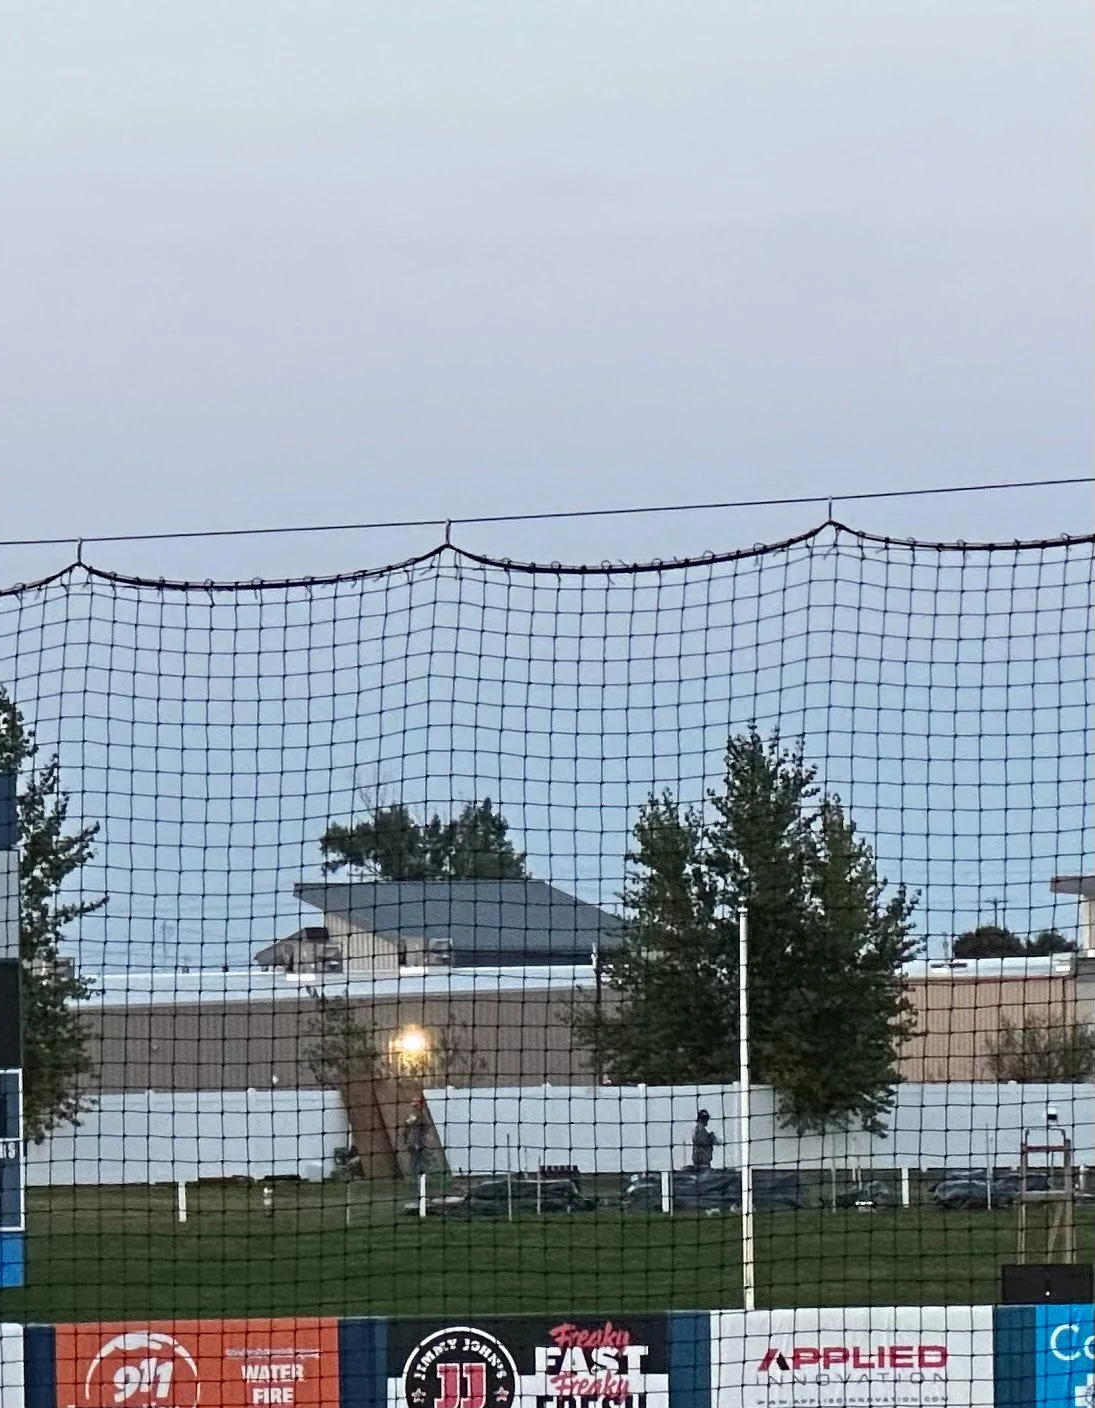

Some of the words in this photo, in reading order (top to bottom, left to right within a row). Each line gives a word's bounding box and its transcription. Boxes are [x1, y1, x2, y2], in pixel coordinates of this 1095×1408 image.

[549, 1321, 632, 1349] Freaky
[413, 1338, 458, 1381] JIMMY
[462, 1337, 508, 1380] JOHN'S
[535, 1346, 649, 1375] FAST
[758, 1346, 949, 1371] APPLIED
[113, 1358, 174, 1402] 911
[241, 1363, 305, 1383] WATER
[756, 1372, 949, 1387] INNOVATION
[252, 1388, 294, 1404] FIRE
[550, 1370, 632, 1405] Freaky
